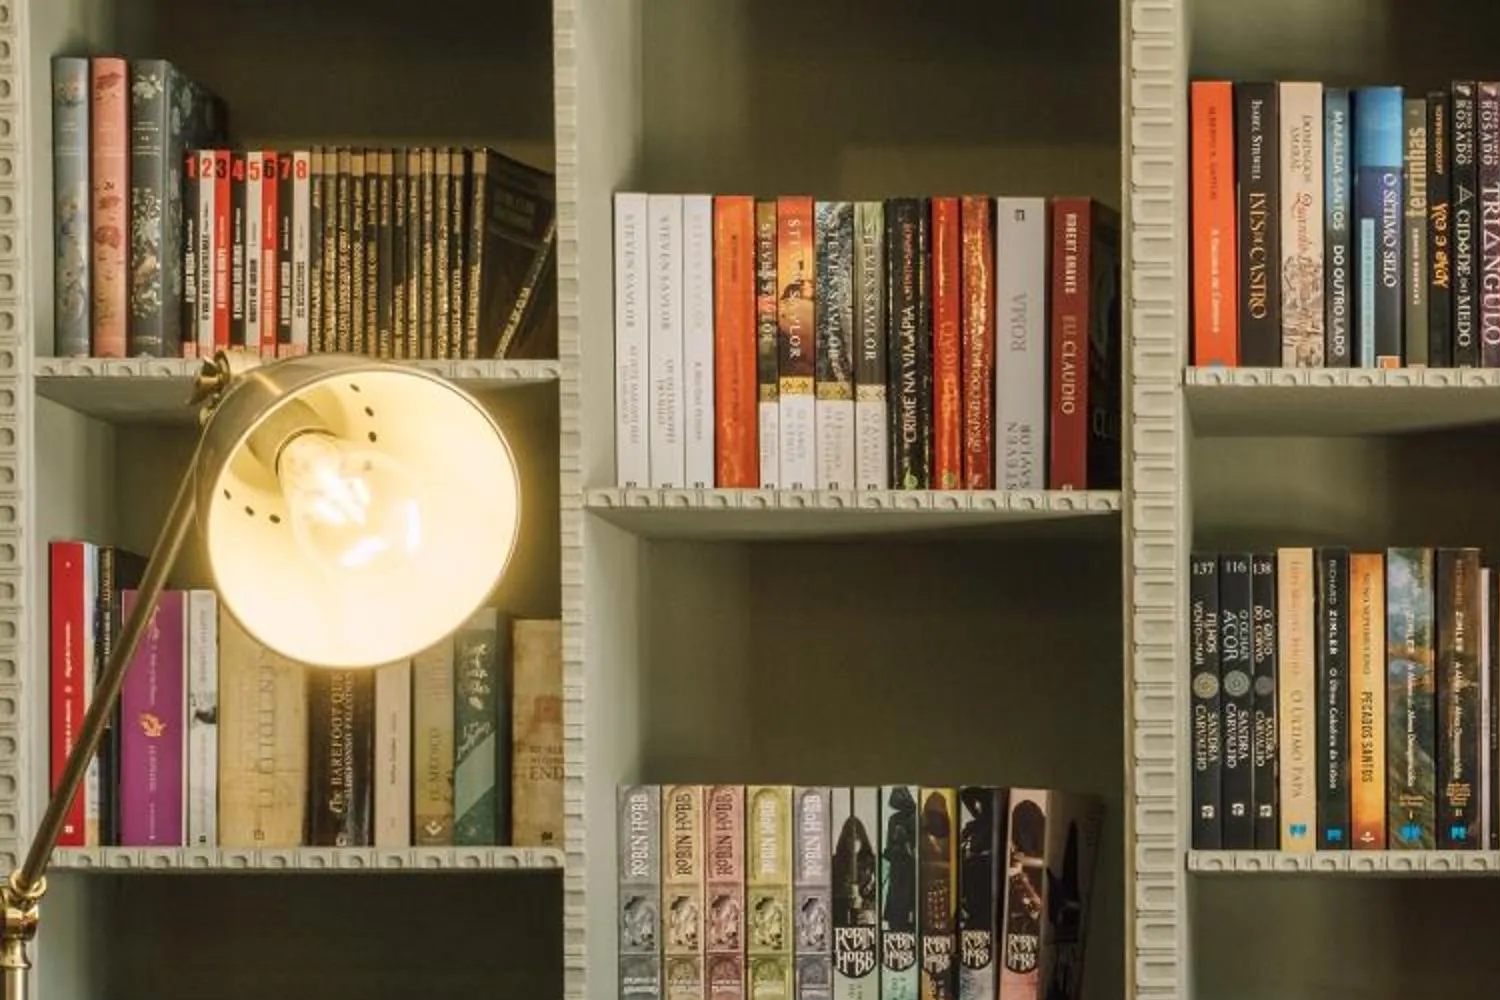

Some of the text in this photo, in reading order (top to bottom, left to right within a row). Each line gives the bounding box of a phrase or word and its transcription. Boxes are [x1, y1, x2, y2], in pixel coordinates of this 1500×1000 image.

[1456, 100, 1467, 165] ROSADO
[1482, 100, 1493, 166] ROSADO
[1333, 111, 1344, 231] MAFALDA SANTOS
[1404, 128, 1427, 218] terrinhas
[1383, 172, 1399, 287] O SÉTIMO SELO
[1011, 292, 1027, 352] ROMA
[1333, 245, 1345, 356] DO OUTRO LADO
[1457, 295, 1471, 346] MEDO
[902, 371, 916, 393] NA
[902, 395, 917, 443] CRIME
